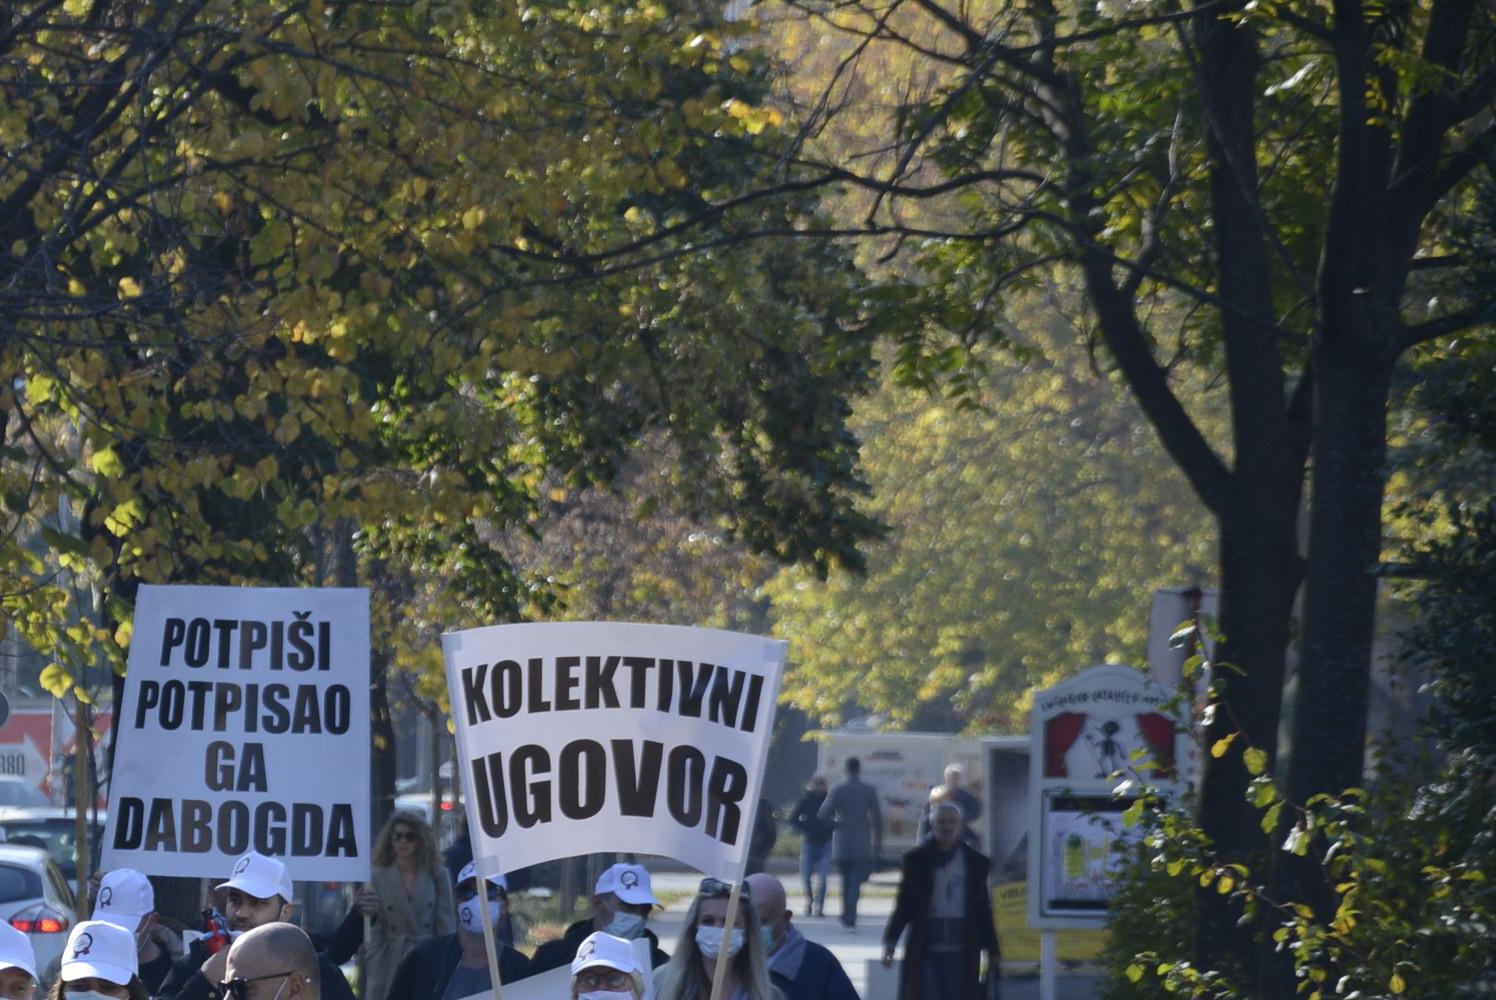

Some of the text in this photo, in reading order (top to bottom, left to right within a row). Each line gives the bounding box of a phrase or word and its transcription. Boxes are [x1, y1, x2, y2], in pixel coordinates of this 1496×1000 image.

[160, 611, 331, 671] POTPIŠI
[135, 679, 351, 735] POTPISAO
[461, 655, 765, 733] KOLEKTIVNI
[205, 740, 268, 793] GA
[471, 738, 748, 846] UGOVOR
[113, 796, 359, 857] DABOGDA
